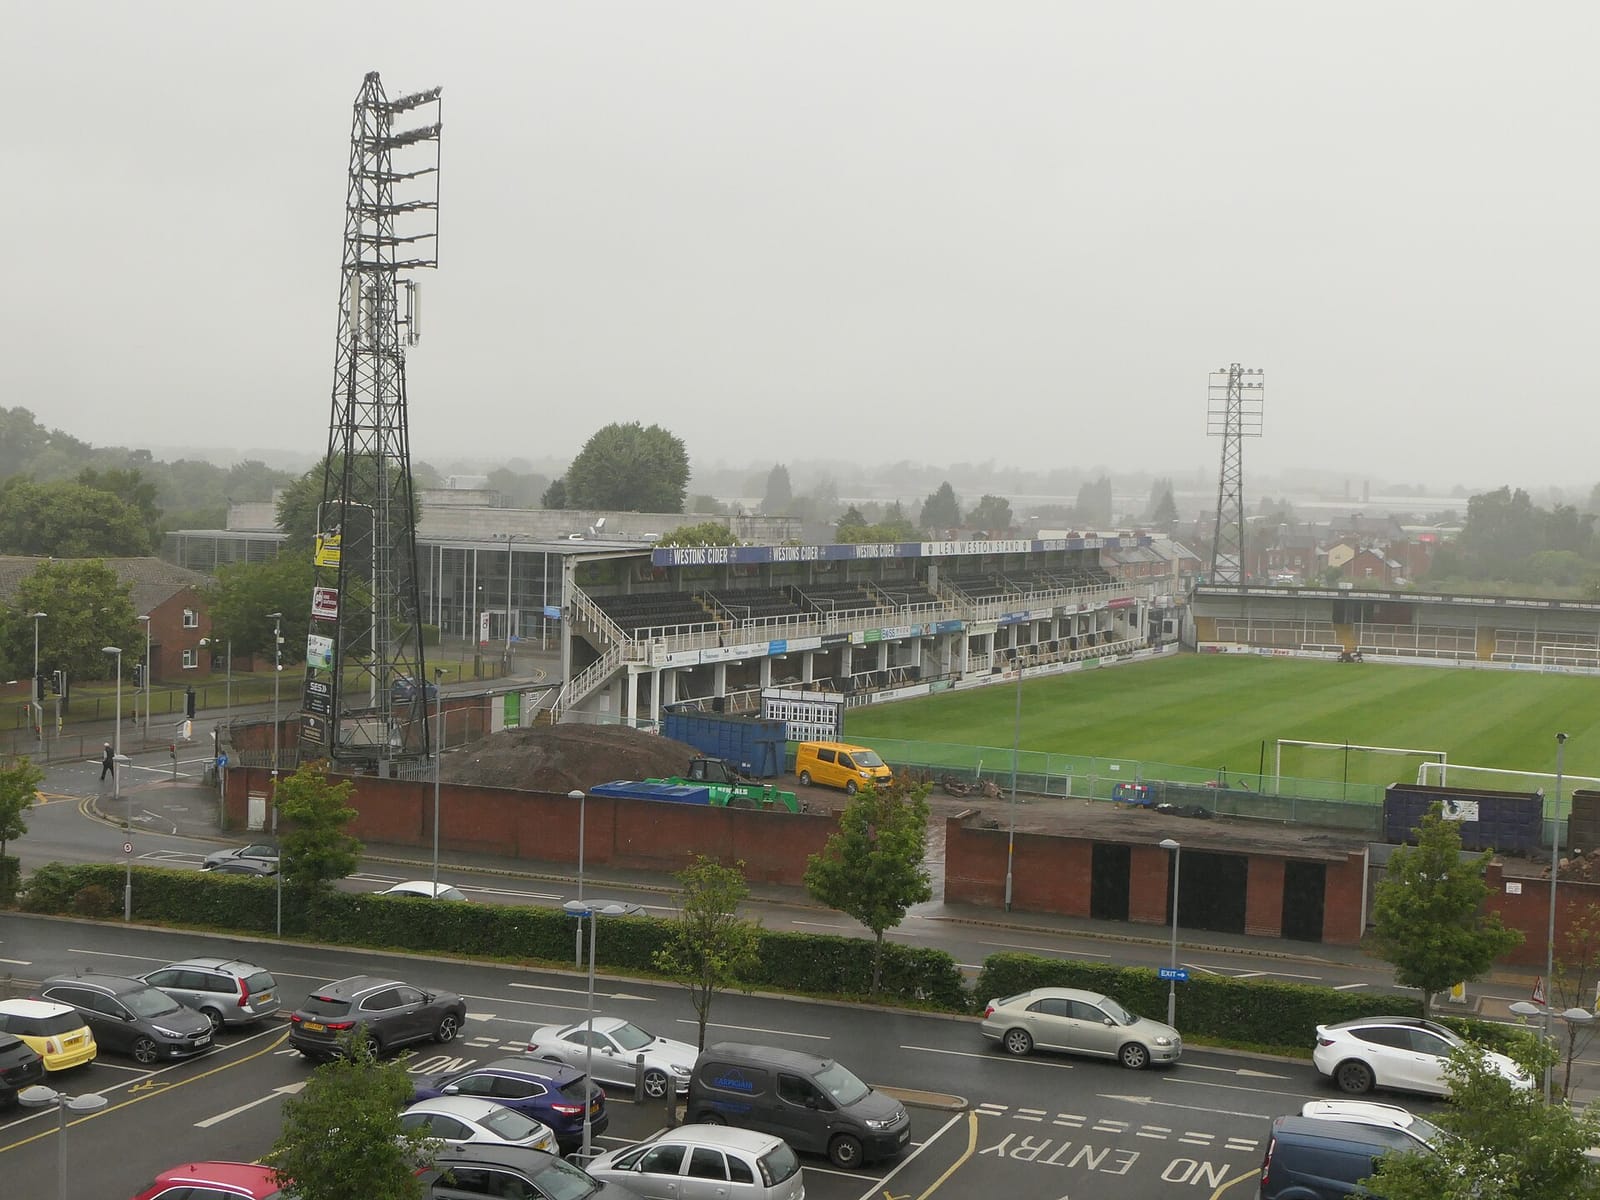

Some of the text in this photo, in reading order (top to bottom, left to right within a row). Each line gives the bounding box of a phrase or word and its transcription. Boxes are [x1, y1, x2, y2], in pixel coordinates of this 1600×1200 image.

[772, 546, 819, 561] WESTONS CIDER
[856, 543, 895, 559] WESTONS CIDER
[939, 540, 1019, 555] LEN WESTON STAND
[673, 548, 728, 565] WESTONS CIDER
[1160, 969, 1177, 977] EXIT
[979, 1133, 1230, 1188] NO ENTRY
